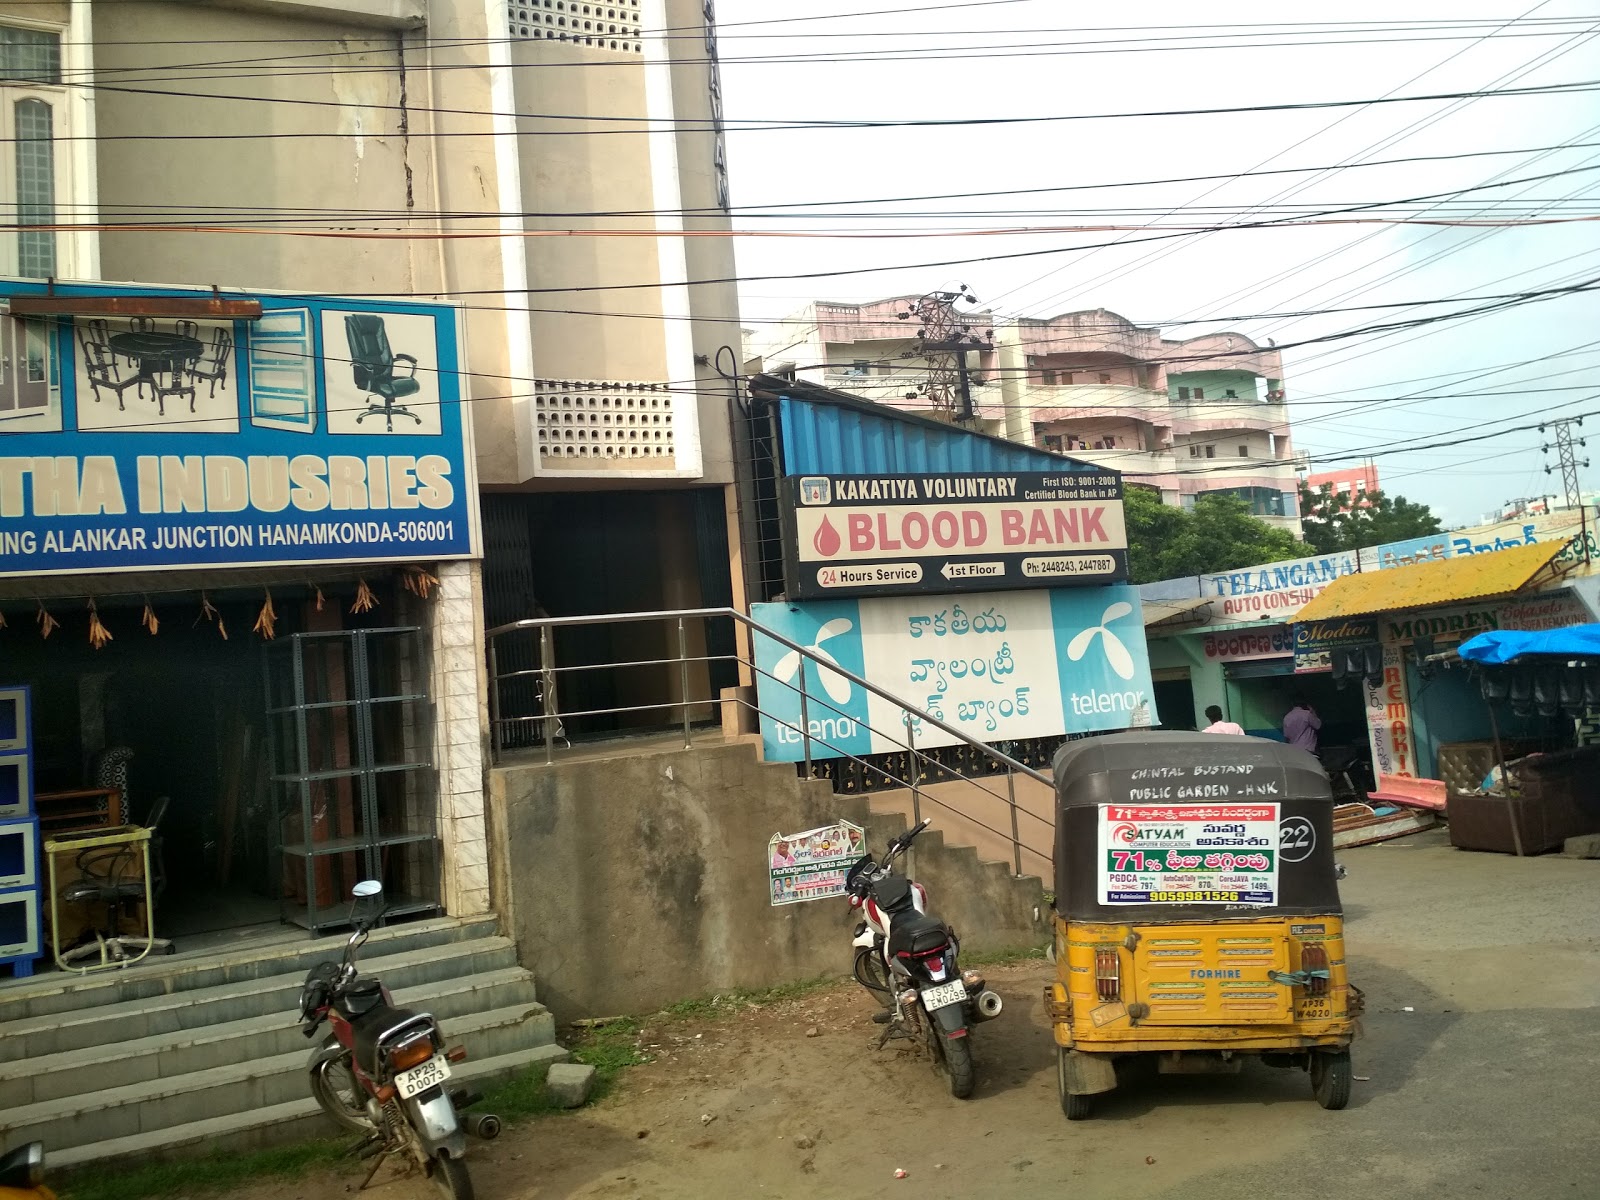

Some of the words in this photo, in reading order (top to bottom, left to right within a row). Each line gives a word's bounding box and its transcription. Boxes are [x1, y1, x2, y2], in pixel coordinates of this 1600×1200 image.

[136, 454, 454, 513] INDUSRIES
[835, 479, 918, 500] KAKATIYA
[922, 477, 1017, 499] VOLUNTARY
[1042, 477, 1060, 487] First
[1061, 477, 1077, 487] ISO:
[1078, 476, 1116, 486] 9001-2008
[1024, 490, 1056, 500] Certified
[1057, 489, 1078, 499] Blood
[1079, 489, 1098, 499] Bank
[1099, 489, 1106, 498] in
[1107, 489, 1117, 498] AP
[42, 527, 148, 553] ALANKAR
[152, 524, 253, 550] JUNCTION
[258, 519, 454, 546] HANAMKONDA-506001
[847, 510, 987, 552] BLOOD
[1000, 506, 1110, 546] BANK
[822, 569, 837, 585] 24
[840, 570, 873, 582] Hours
[876, 568, 918, 580] Service
[949, 565, 966, 576] 1st
[969, 564, 997, 575] Floor
[1026, 562, 1040, 574] Ph:
[1041, 560, 1078, 573] 2448243,
[1078, 559, 1111, 571] 2447887
[1212, 555, 1354, 597] TELANGANA
[1224, 596, 1262, 615] AUTO
[908, 604, 1007, 638] కాకతీయ
[1389, 609, 1500, 641] MODREN
[1542, 613, 1588, 629] REMAKING
[1297, 622, 1371, 643] Modren
[1206, 635, 1271, 658] తెలంగాణ
[1384, 656, 1400, 666] SOFA
[957, 686, 1031, 732] బ్యాంక్
[1070, 688, 1144, 715] telenor
[774, 714, 861, 744] telenor
[1129, 786, 1172, 800] PUBLIC
[1176, 784, 1230, 799] GARDEN
[1126, 828, 1185, 840] SATYAM
[1203, 824, 1246, 837] సువర్ణ
[1279, 825, 1310, 850] 22
[1196, 837, 1270, 846] అవకాశం
[1109, 874, 1138, 882] PGDCA
[1149, 891, 1239, 902] 9059981526
[407, 1062, 436, 1083] AP29
